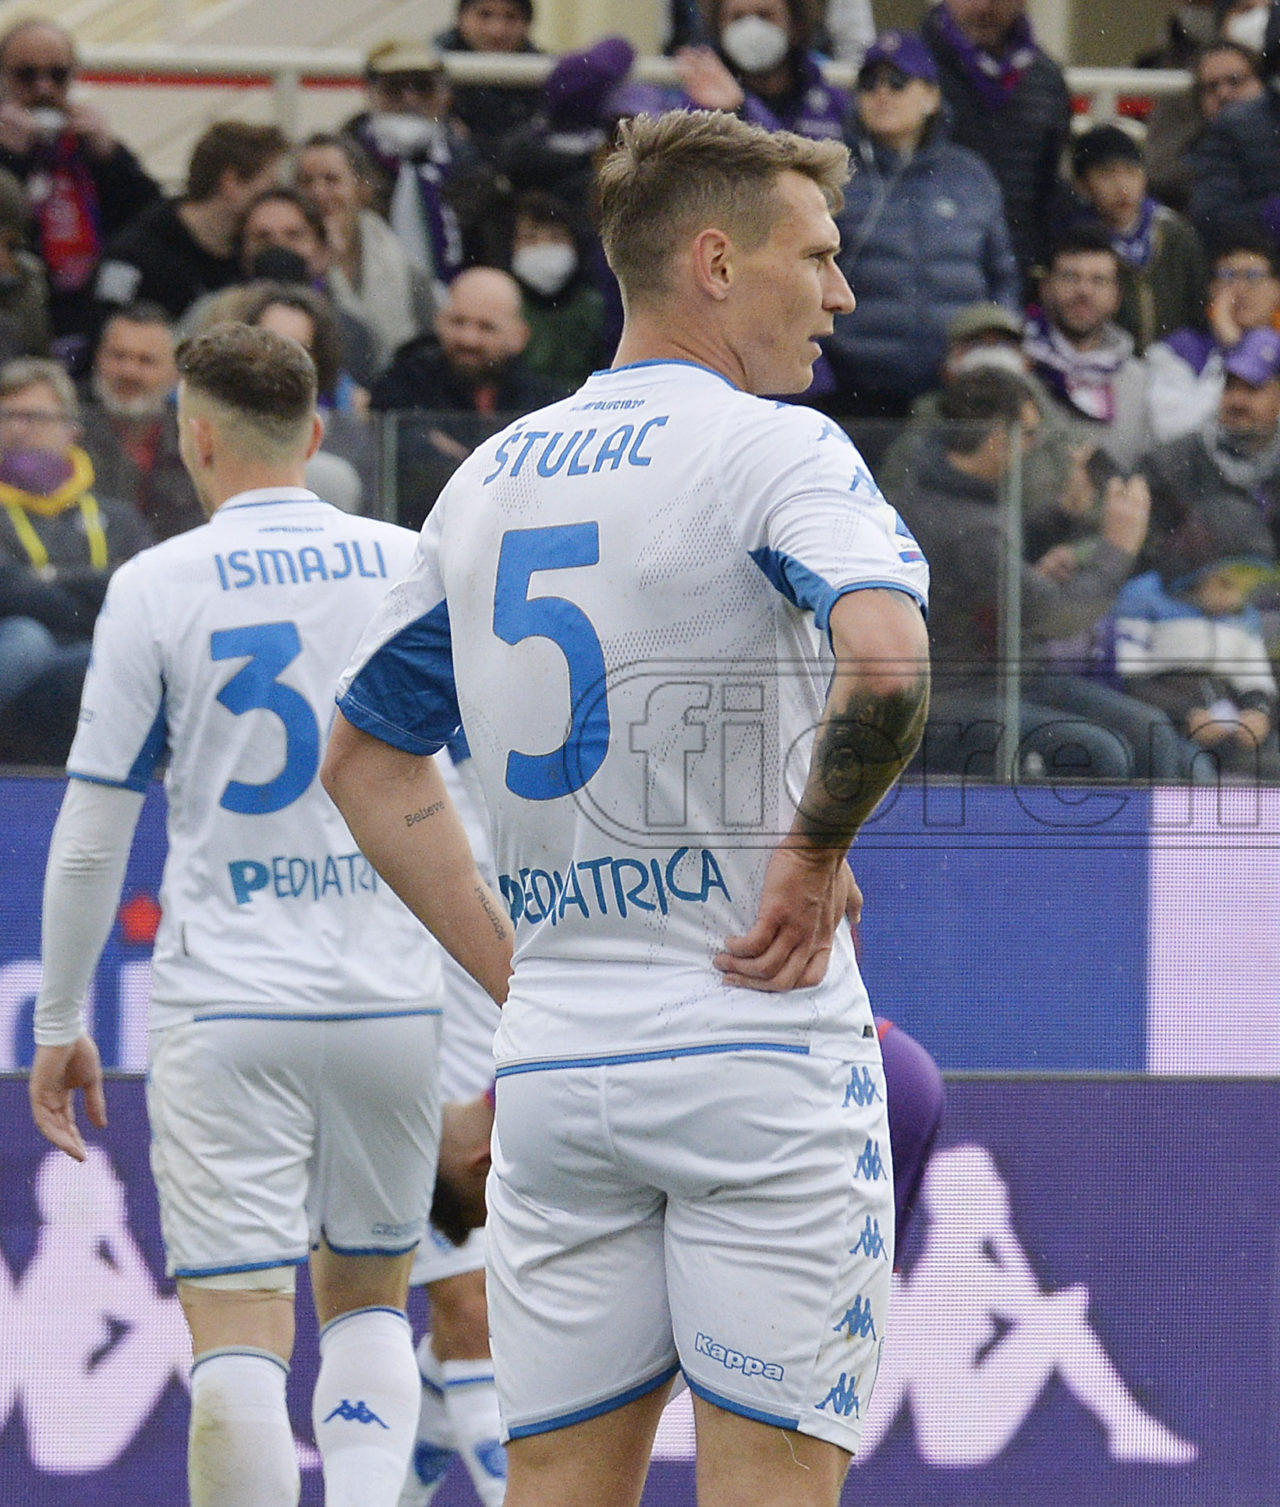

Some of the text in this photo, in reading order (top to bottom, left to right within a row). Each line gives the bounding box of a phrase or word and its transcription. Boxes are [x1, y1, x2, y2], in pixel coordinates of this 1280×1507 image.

[483, 415, 670, 485] ŠTULAC
[214, 540, 388, 591] ISMAJLI
[492, 520, 611, 800] 5
[210, 621, 320, 815] 3
[404, 800, 446, 828] Believe
[498, 846, 732, 930] PEDIATRICA
[695, 1332, 785, 1382] Kappa
